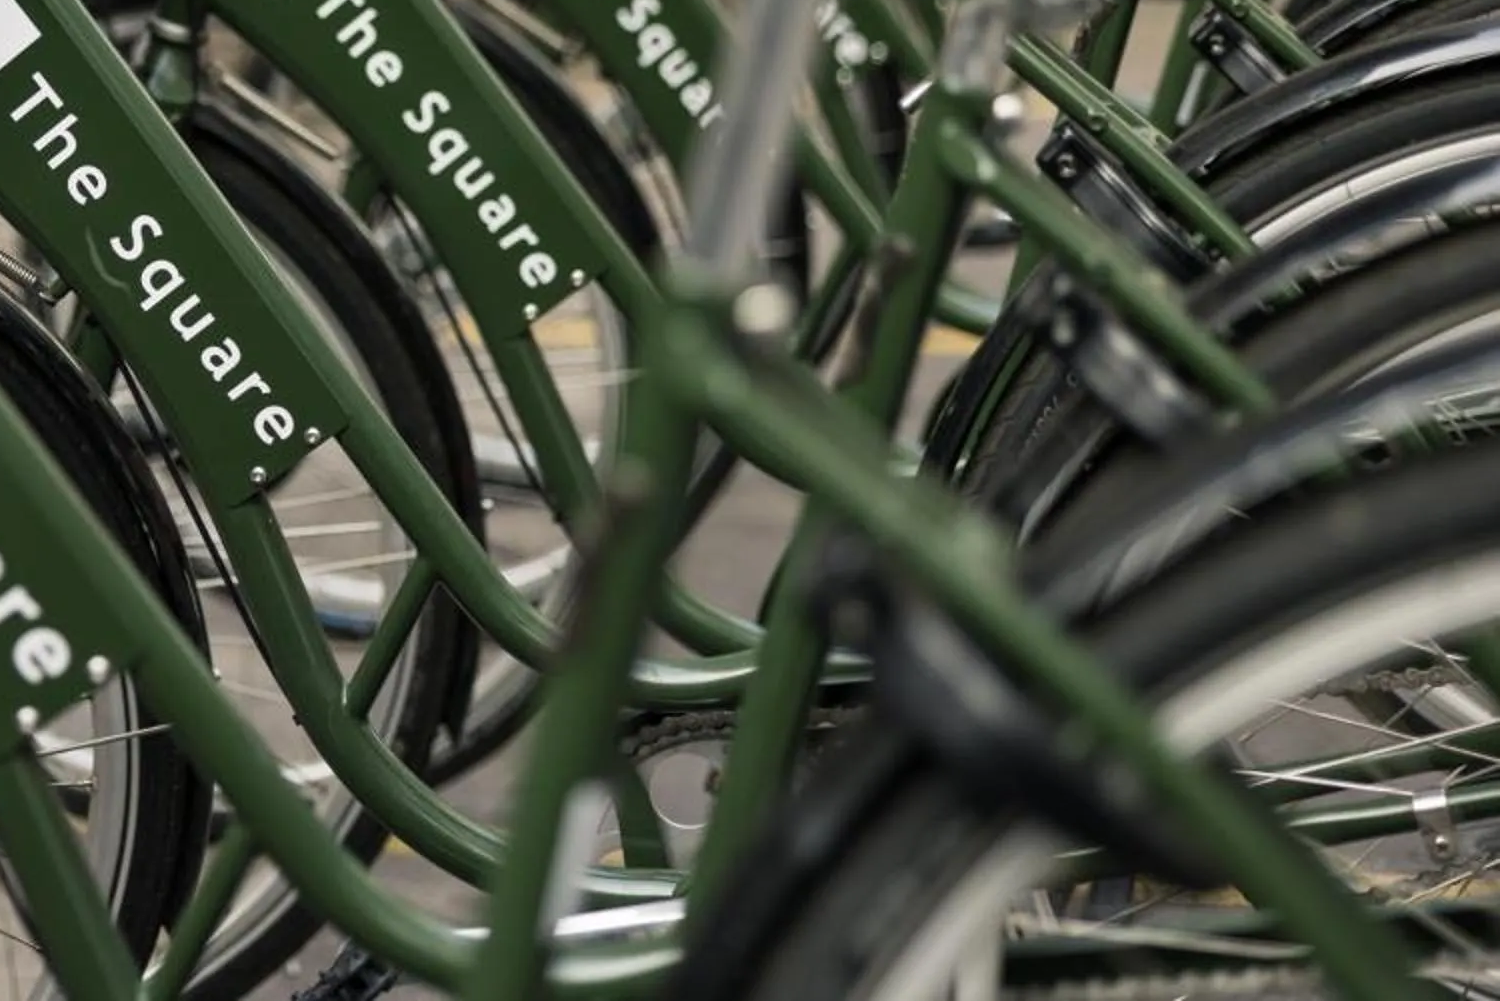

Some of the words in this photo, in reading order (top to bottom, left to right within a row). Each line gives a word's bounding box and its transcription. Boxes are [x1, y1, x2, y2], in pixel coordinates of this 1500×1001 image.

[8, 70, 108, 207] The
[108, 213, 296, 446] Square
[401, 89, 558, 289] Square
